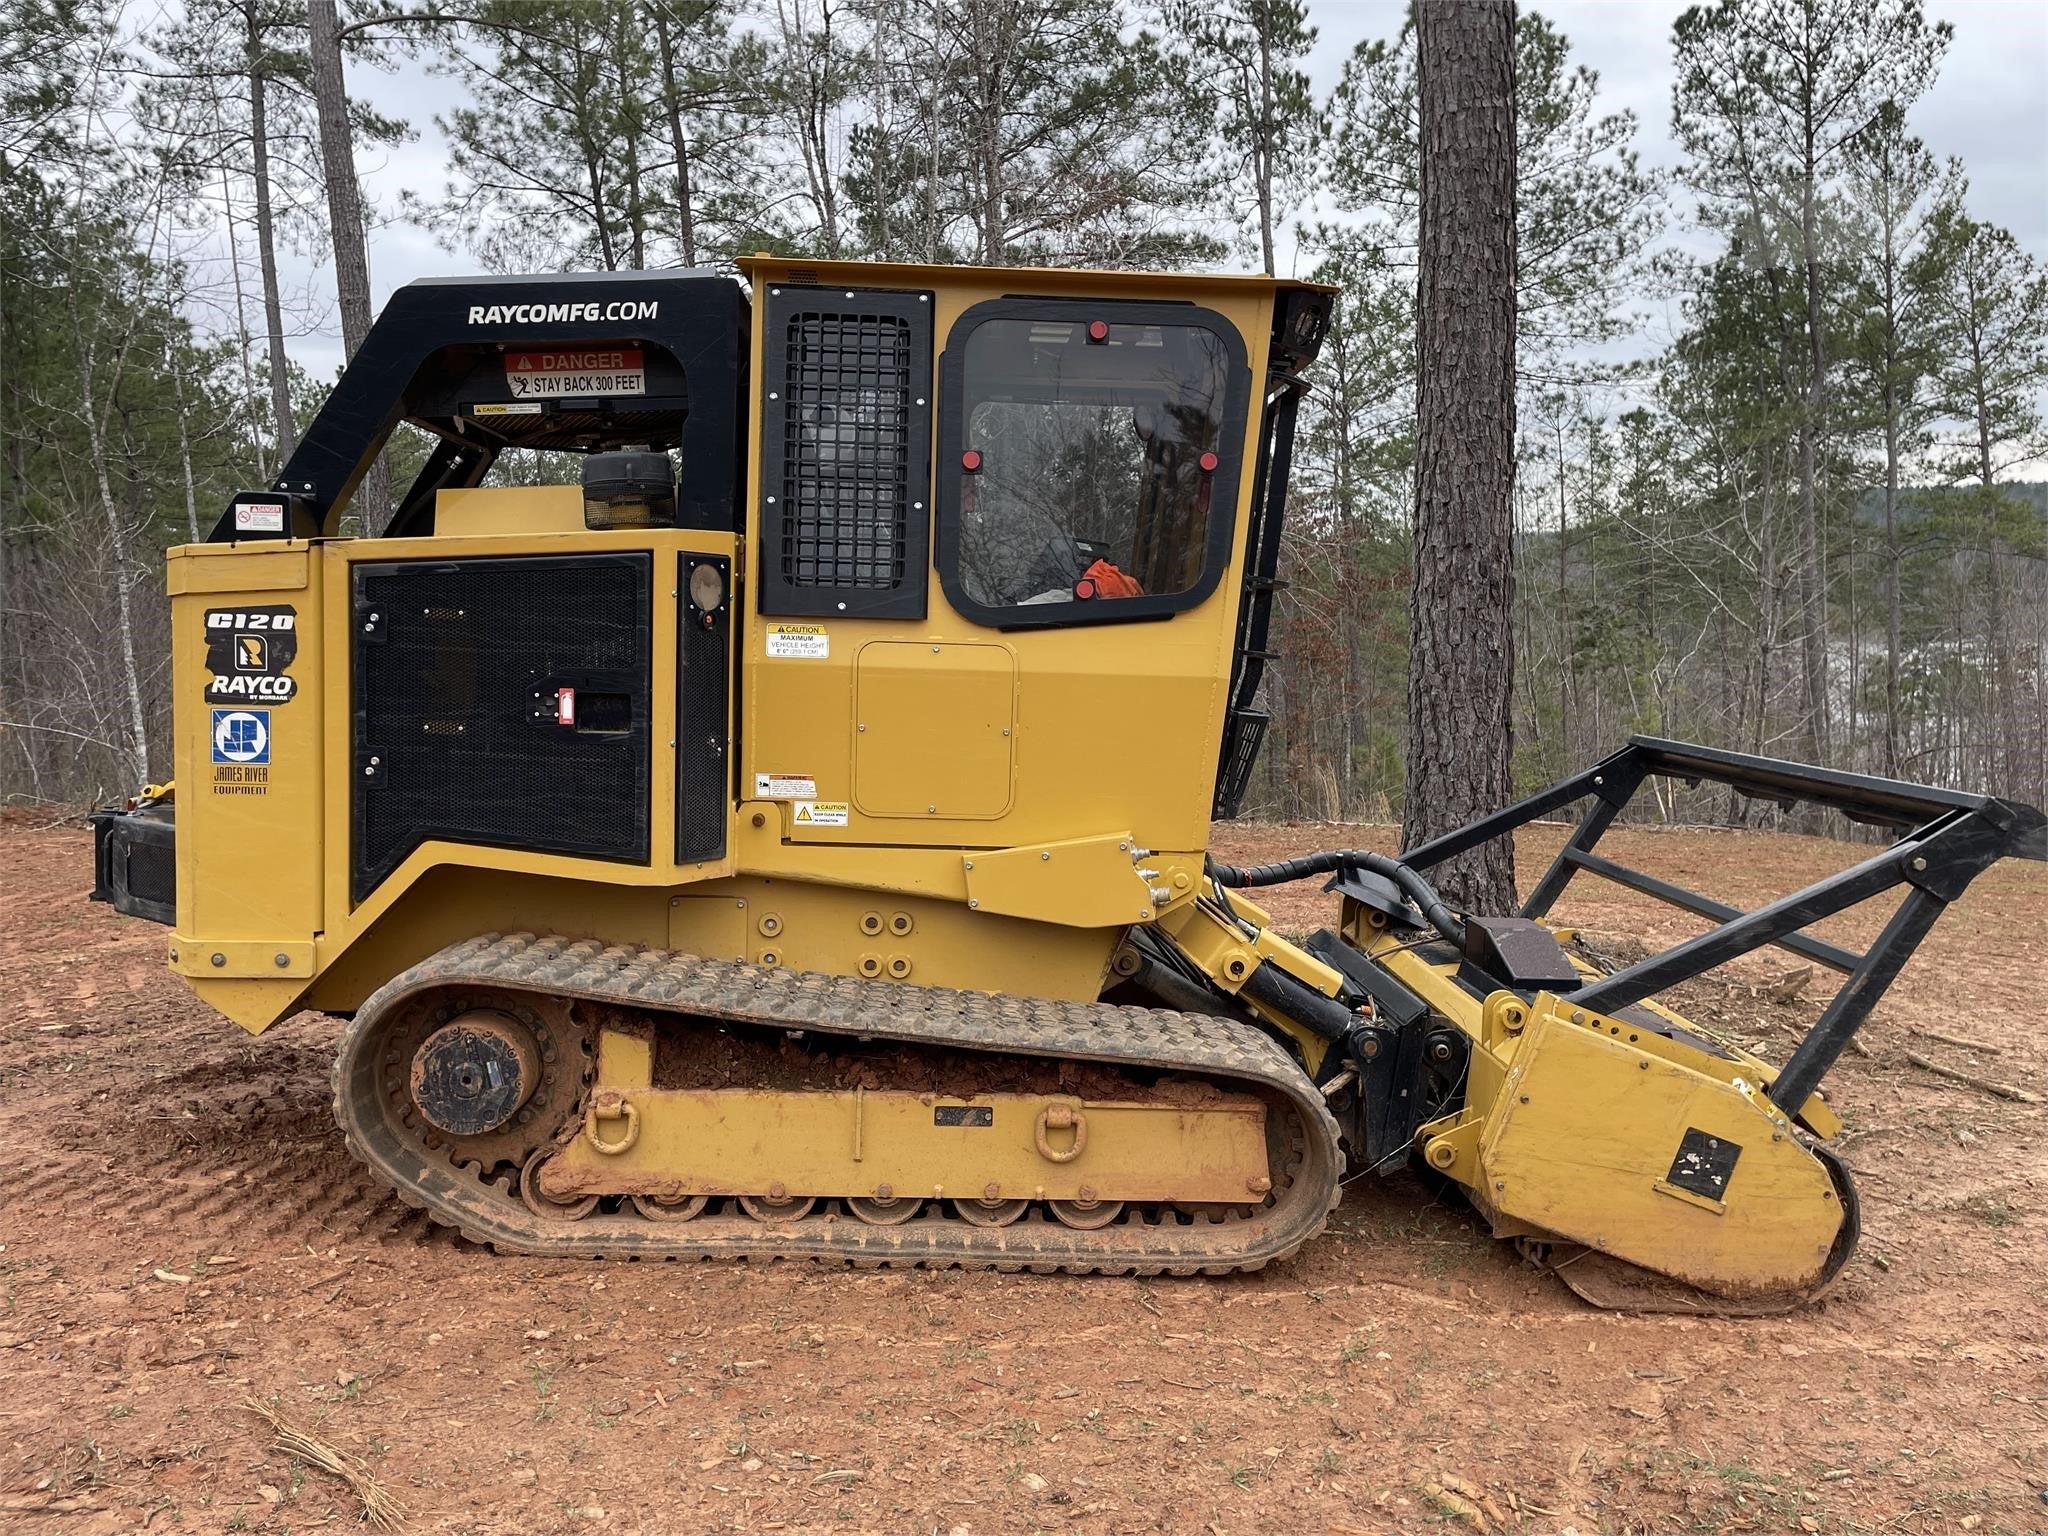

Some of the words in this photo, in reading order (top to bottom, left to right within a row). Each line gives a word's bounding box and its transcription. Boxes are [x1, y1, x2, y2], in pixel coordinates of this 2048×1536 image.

[468, 301, 659, 325] RAYCOMFG.COM
[542, 353, 624, 370] DANGER
[534, 377, 561, 393] STAY
[564, 376, 594, 392] BACK
[596, 375, 613, 391] 300
[616, 374, 642, 390] FEET
[211, 675, 292, 694] RAYCO
[213, 766, 242, 783] JAMES
[244, 767, 268, 783] RIVER
[213, 785, 268, 795] EQUIPMENT
